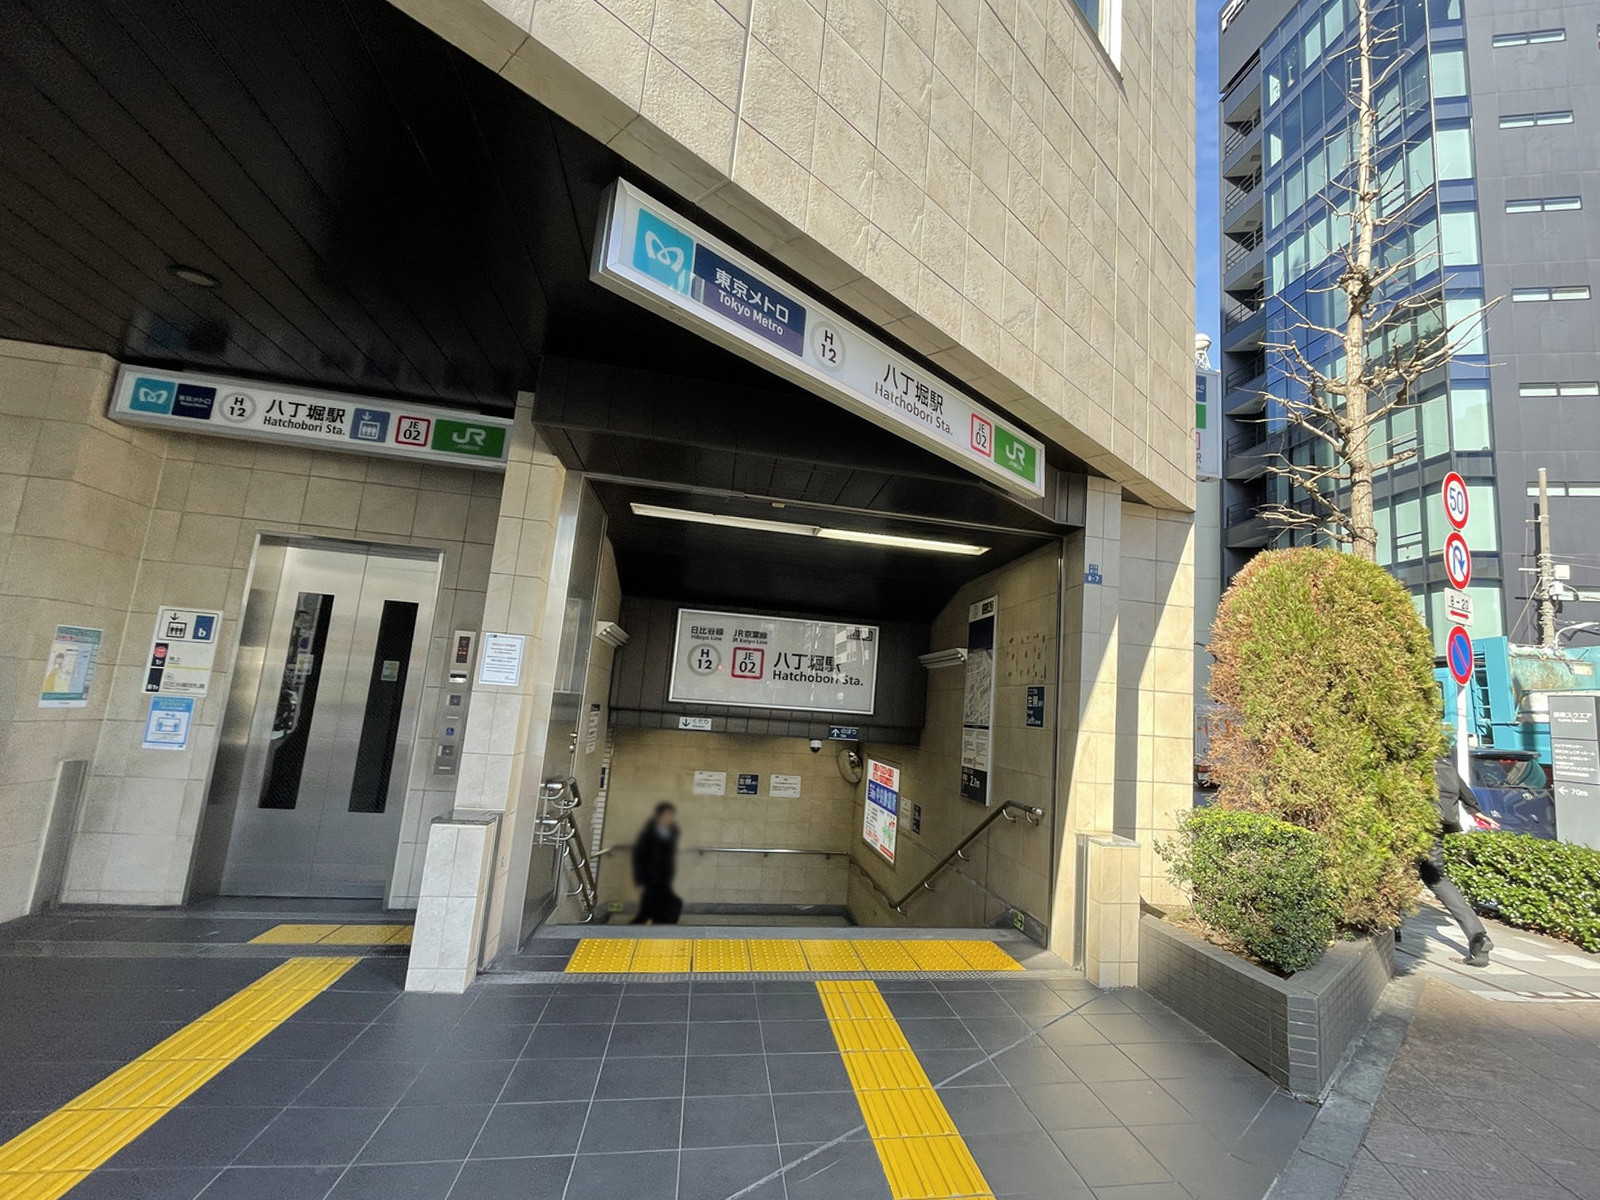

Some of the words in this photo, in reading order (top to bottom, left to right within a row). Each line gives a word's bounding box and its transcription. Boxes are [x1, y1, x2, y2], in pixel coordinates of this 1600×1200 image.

[714, 267, 790, 324] 東京メトロ
[718, 290, 751, 317] Tokyo
[753, 309, 785, 335] Metro
[823, 329, 834, 345] H
[820, 343, 837, 363] 12
[882, 363, 944, 415] 八丁堀駅
[234, 396, 244, 406] H
[228, 405, 246, 418] 12
[265, 398, 347, 425] 八丁堀駅
[874, 381, 933, 425] Hatchobori
[935, 415, 954, 436] Sta.
[262, 415, 324, 433] Hatchobori
[325, 423, 346, 436] Sta.
[408, 420, 421, 431] JE
[977, 422, 986, 434] JE
[402, 428, 422, 442] 02
[452, 427, 487, 447] JR
[975, 433, 988, 448] 02
[1006, 441, 1025, 466] JR
[1449, 487, 1464, 515] 50
[691, 625, 725, 637] 日比谷線
[733, 629, 769, 640] JR京葉線
[700, 648, 710, 658] H
[743, 651, 754, 661] JE
[697, 658, 713, 671] 12
[738, 661, 756, 674] 02
[842, 675, 864, 687] Sta.
[1570, 788, 1589, 797] 70m
